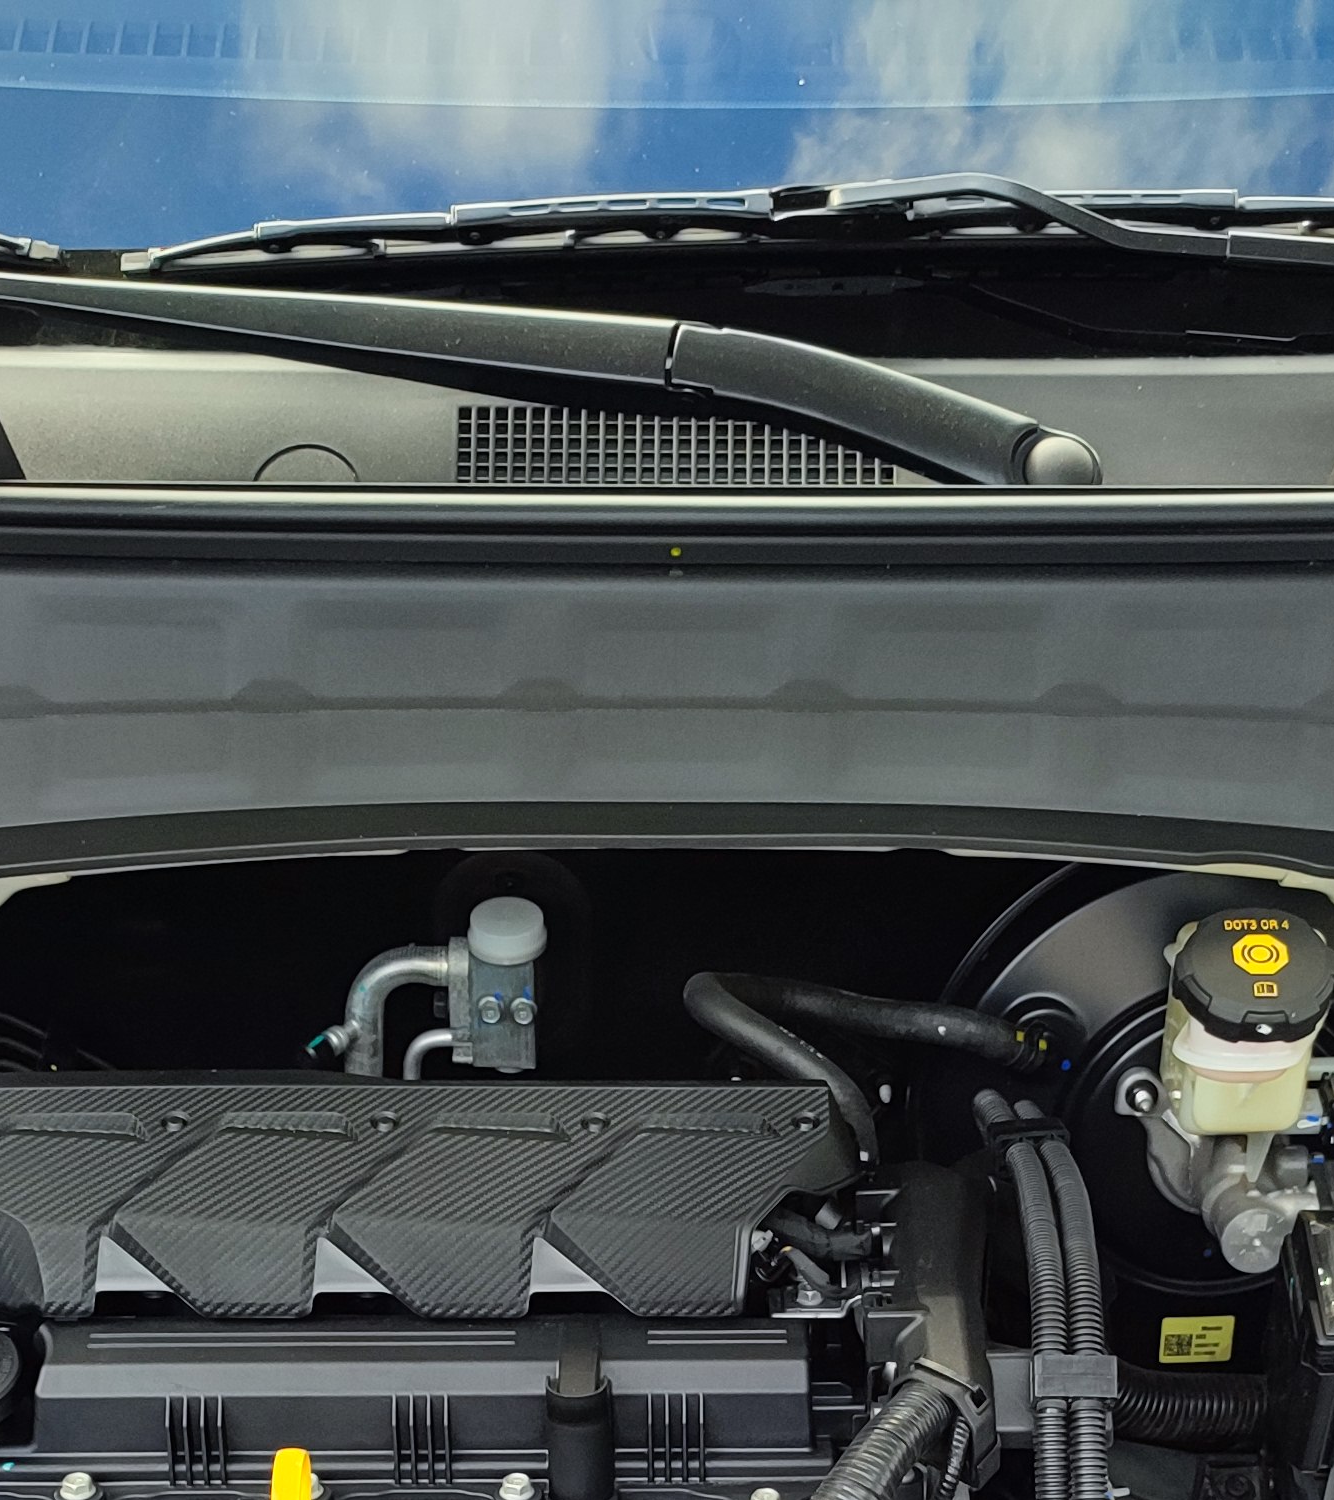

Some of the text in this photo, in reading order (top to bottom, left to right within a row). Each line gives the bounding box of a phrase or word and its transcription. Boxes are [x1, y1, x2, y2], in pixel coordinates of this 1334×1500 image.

[1224, 919, 1289, 930] DOT3 OR 4
